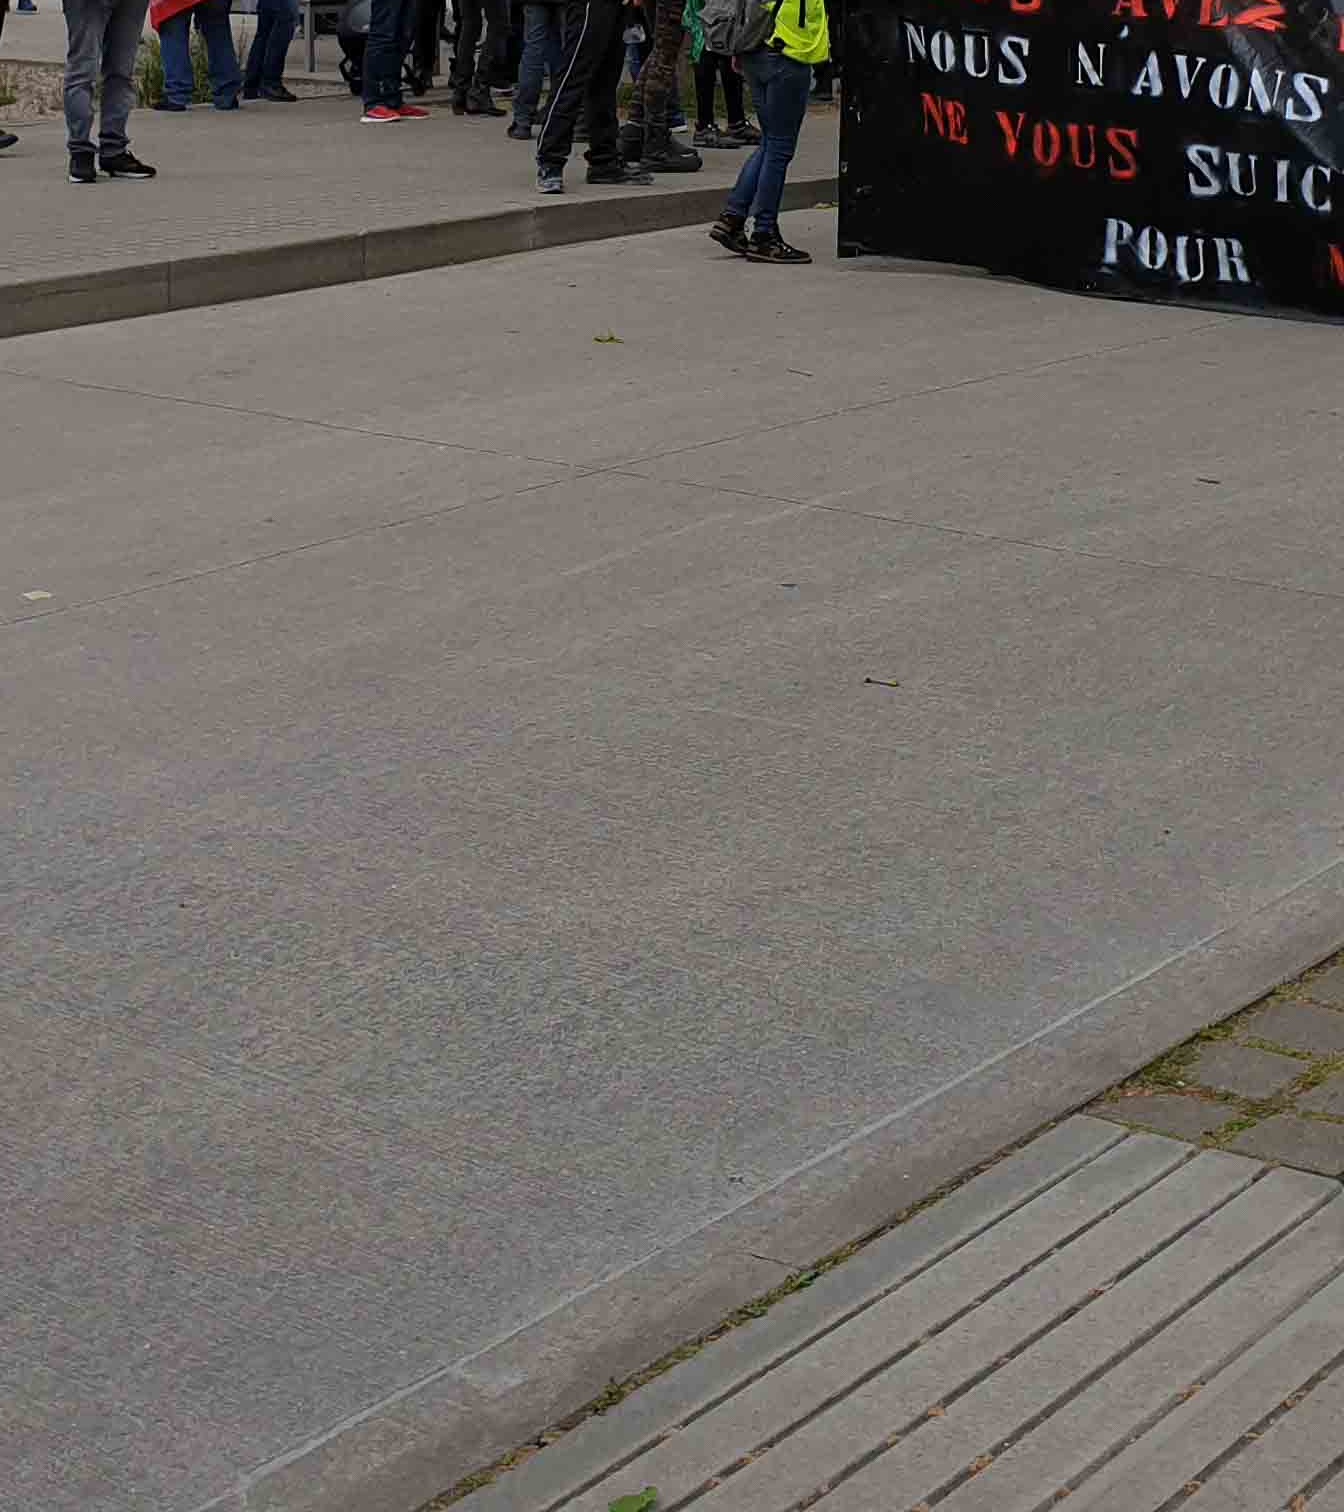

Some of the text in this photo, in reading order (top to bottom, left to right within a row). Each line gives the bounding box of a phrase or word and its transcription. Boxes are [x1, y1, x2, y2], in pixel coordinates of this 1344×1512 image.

[905, 22, 1030, 85] NOUS
[920, 91, 969, 145] NE
[996, 110, 1140, 180] VOUS
[1103, 217, 1250, 284] POUR
